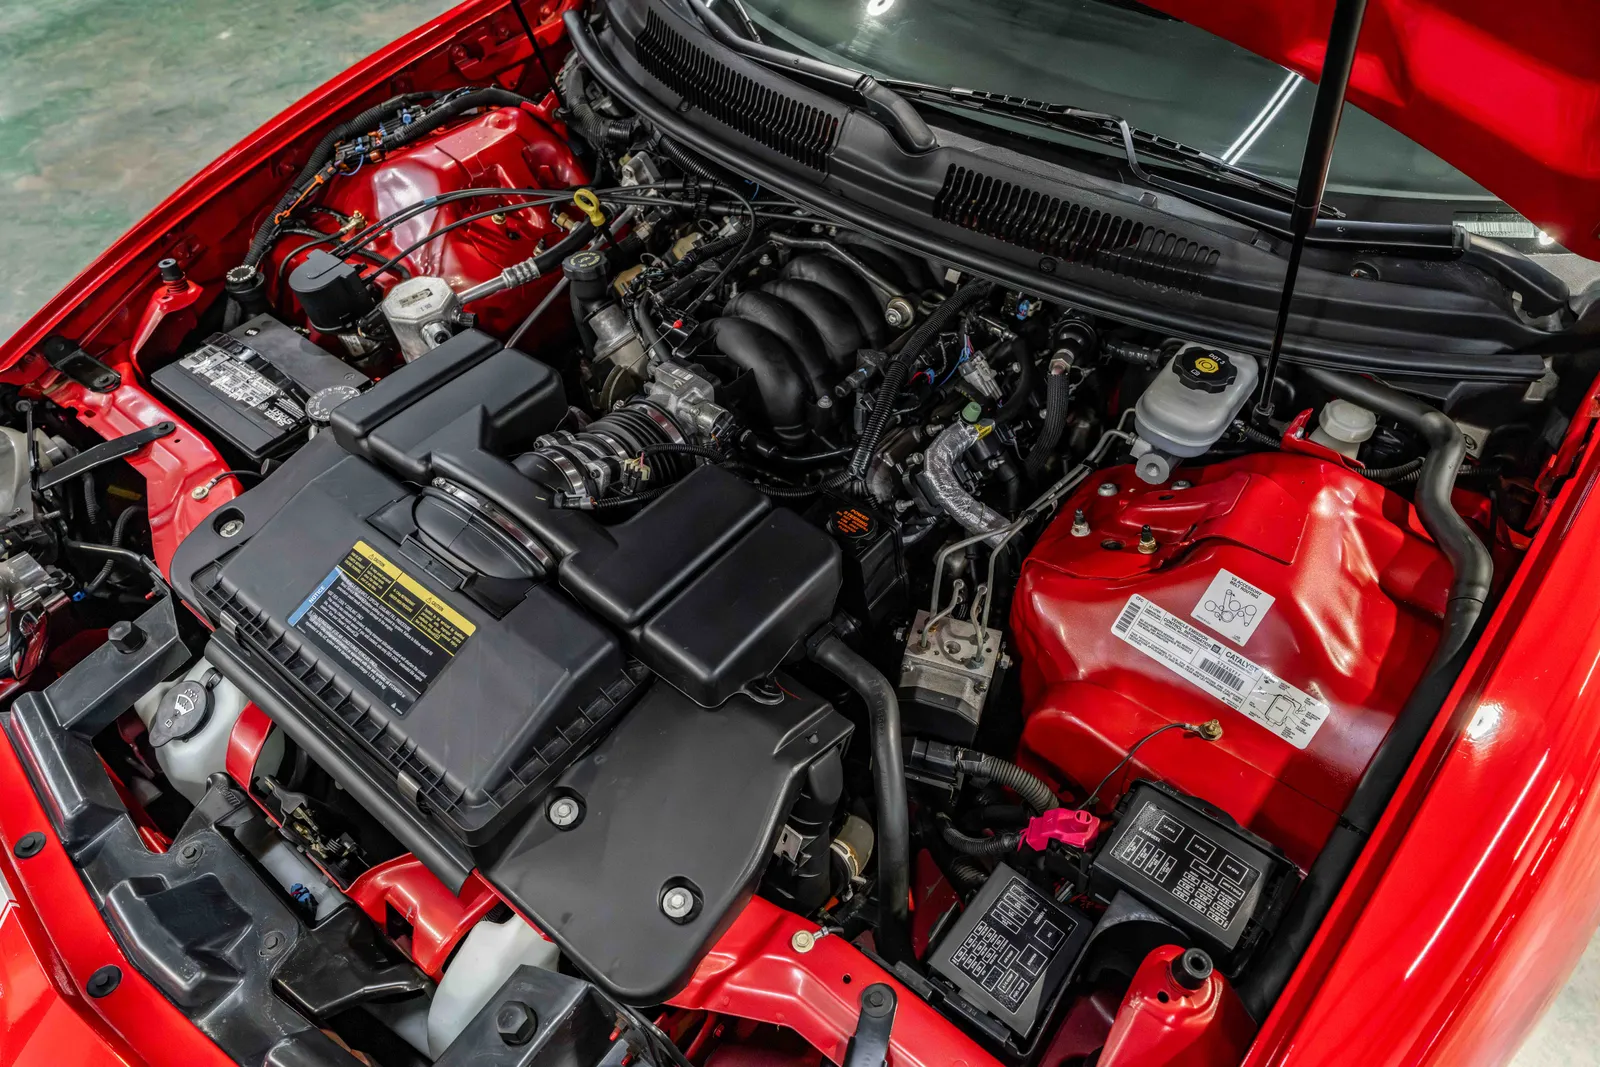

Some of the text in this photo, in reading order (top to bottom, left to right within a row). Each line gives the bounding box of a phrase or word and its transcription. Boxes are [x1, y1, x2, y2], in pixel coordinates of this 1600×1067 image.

[1207, 352, 1222, 362] DOT
[271, 407, 295, 425] START
[842, 511, 868, 526] STEERING
[849, 509, 869, 521] POWER
[308, 585, 326, 605] NOTICE
[1229, 579, 1258, 599] BELT ROUTING
[1236, 579, 1262, 596] ACCESSORY
[430, 600, 444, 611] CAUTION
[1162, 617, 1183, 631] CONTROL
[1183, 629, 1212, 648] INFORMATION
[1170, 616, 1189, 629] VEHICLE
[1188, 627, 1208, 641] EMISSION
[1224, 650, 1258, 673] CATALYST
[1221, 881, 1233, 890] LAMP
